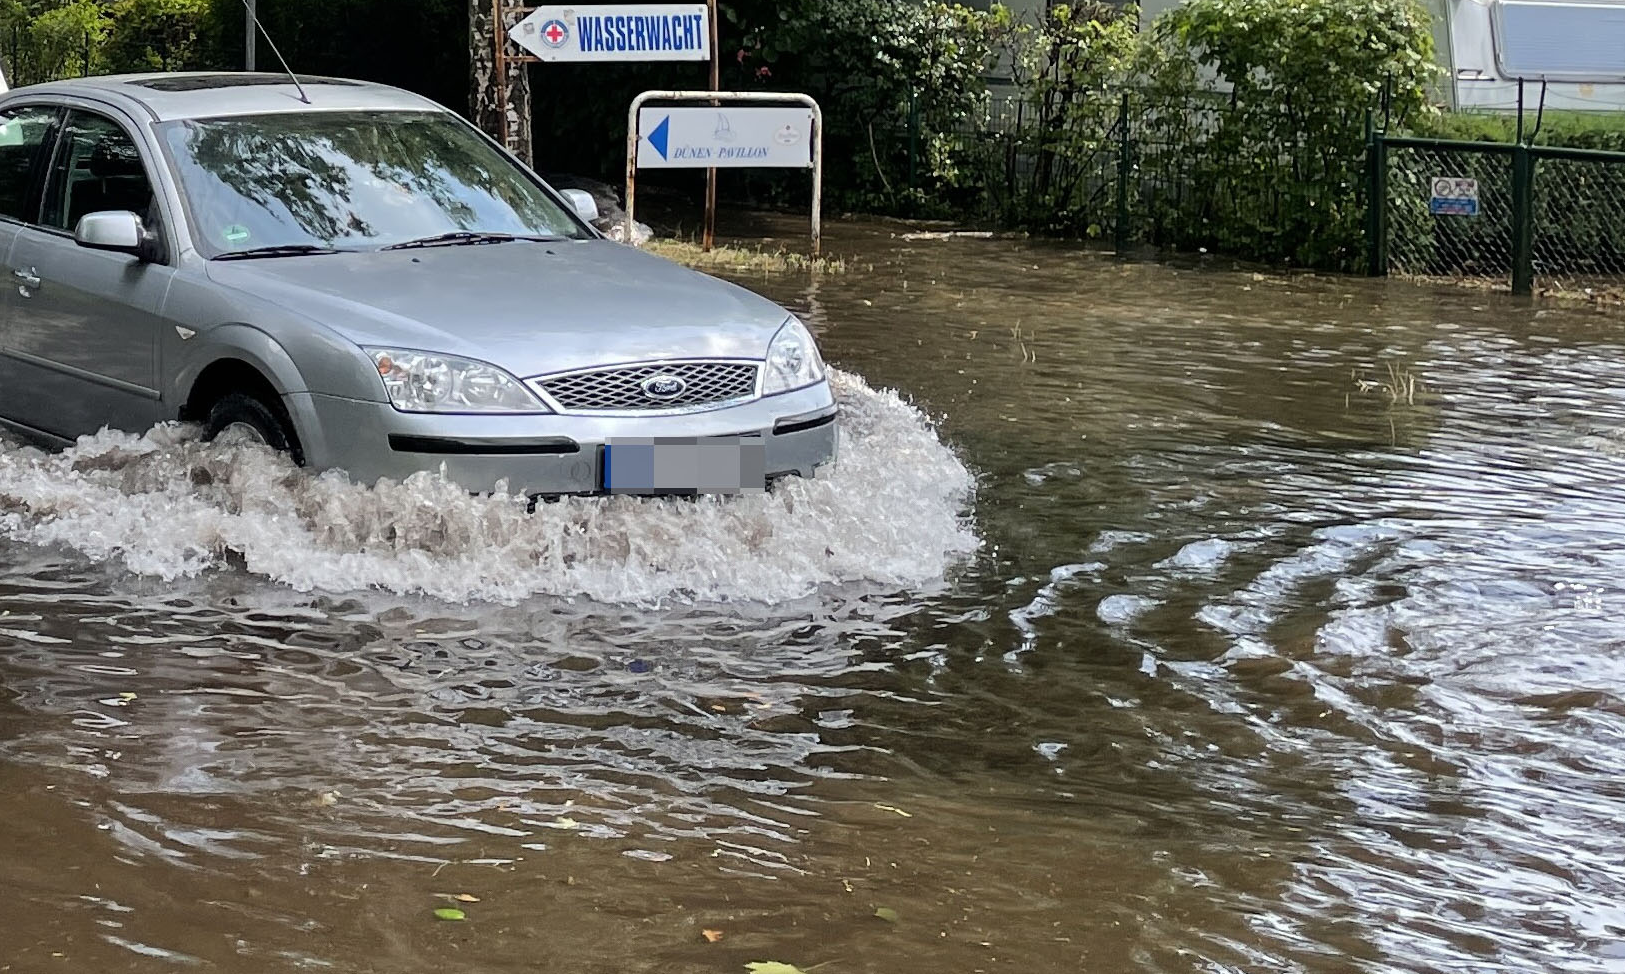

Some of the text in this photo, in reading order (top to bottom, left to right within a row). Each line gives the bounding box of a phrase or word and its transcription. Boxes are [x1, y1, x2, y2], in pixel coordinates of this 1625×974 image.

[577, 14, 703, 52] WASSERWACHT
[673, 144, 711, 159] DÜNEN
[718, 146, 769, 159] PAVILLON
[655, 380, 678, 393] Ford
